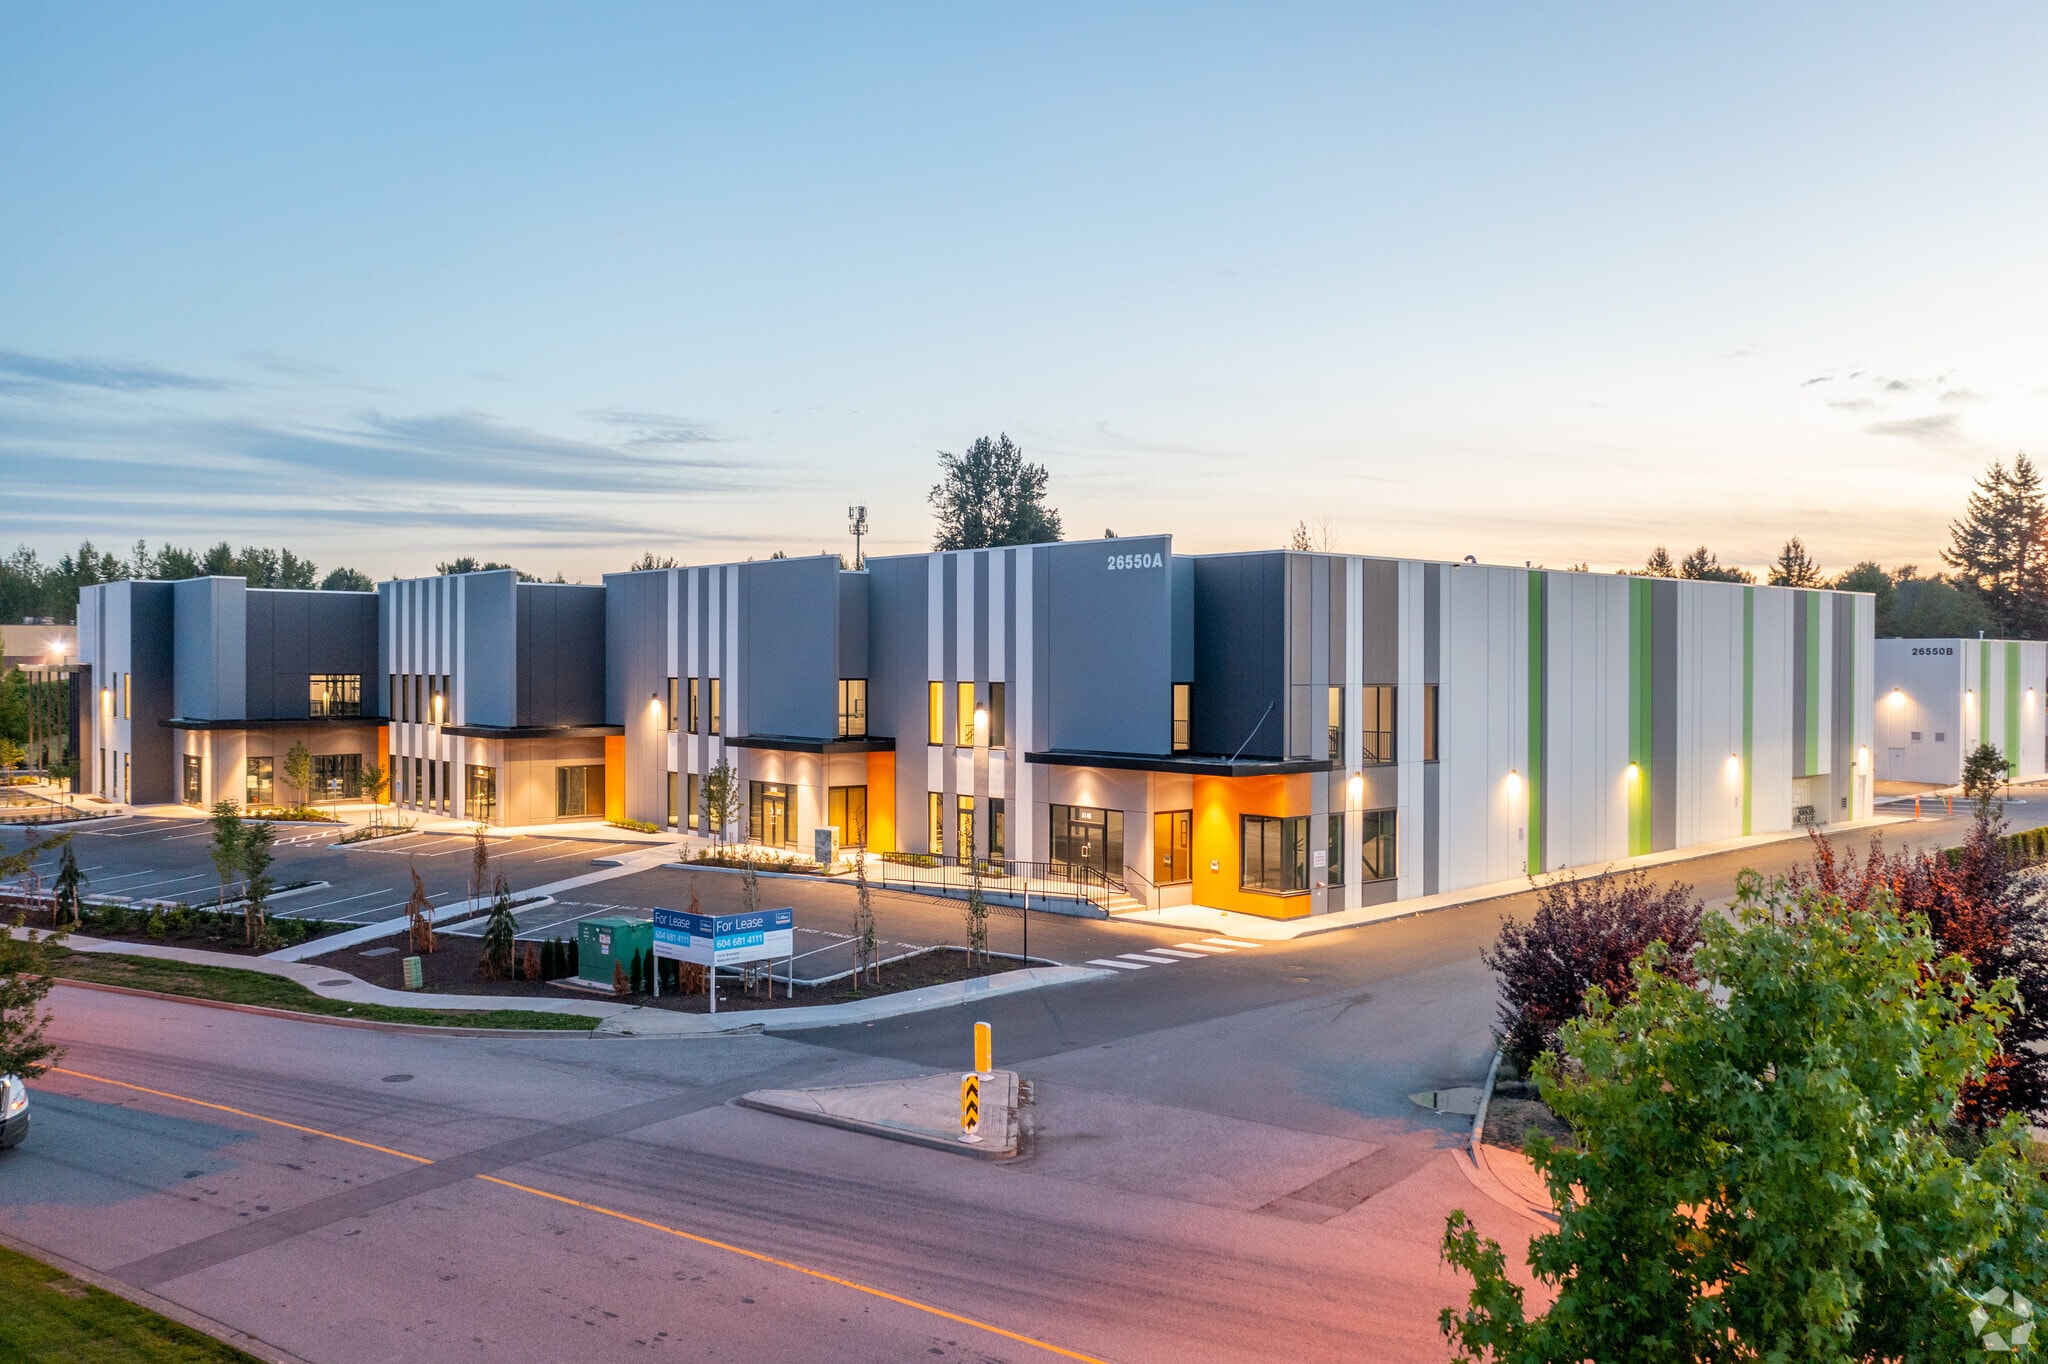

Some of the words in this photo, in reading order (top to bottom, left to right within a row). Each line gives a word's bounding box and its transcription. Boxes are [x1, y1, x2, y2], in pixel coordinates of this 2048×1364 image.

[1107, 552, 1163, 570] 26550A
[1911, 647, 1953, 656] 26550B
[654, 912, 667, 925] For
[669, 915, 690, 929] Lease
[716, 920, 733, 933] For
[735, 917, 763, 930] Lease
[655, 930, 666, 939] 604
[666, 933, 676, 942] 681
[677, 935, 689, 944] 4111
[716, 939, 731, 948] 604
[732, 937, 746, 946] 681
[747, 934, 763, 944] 4111
